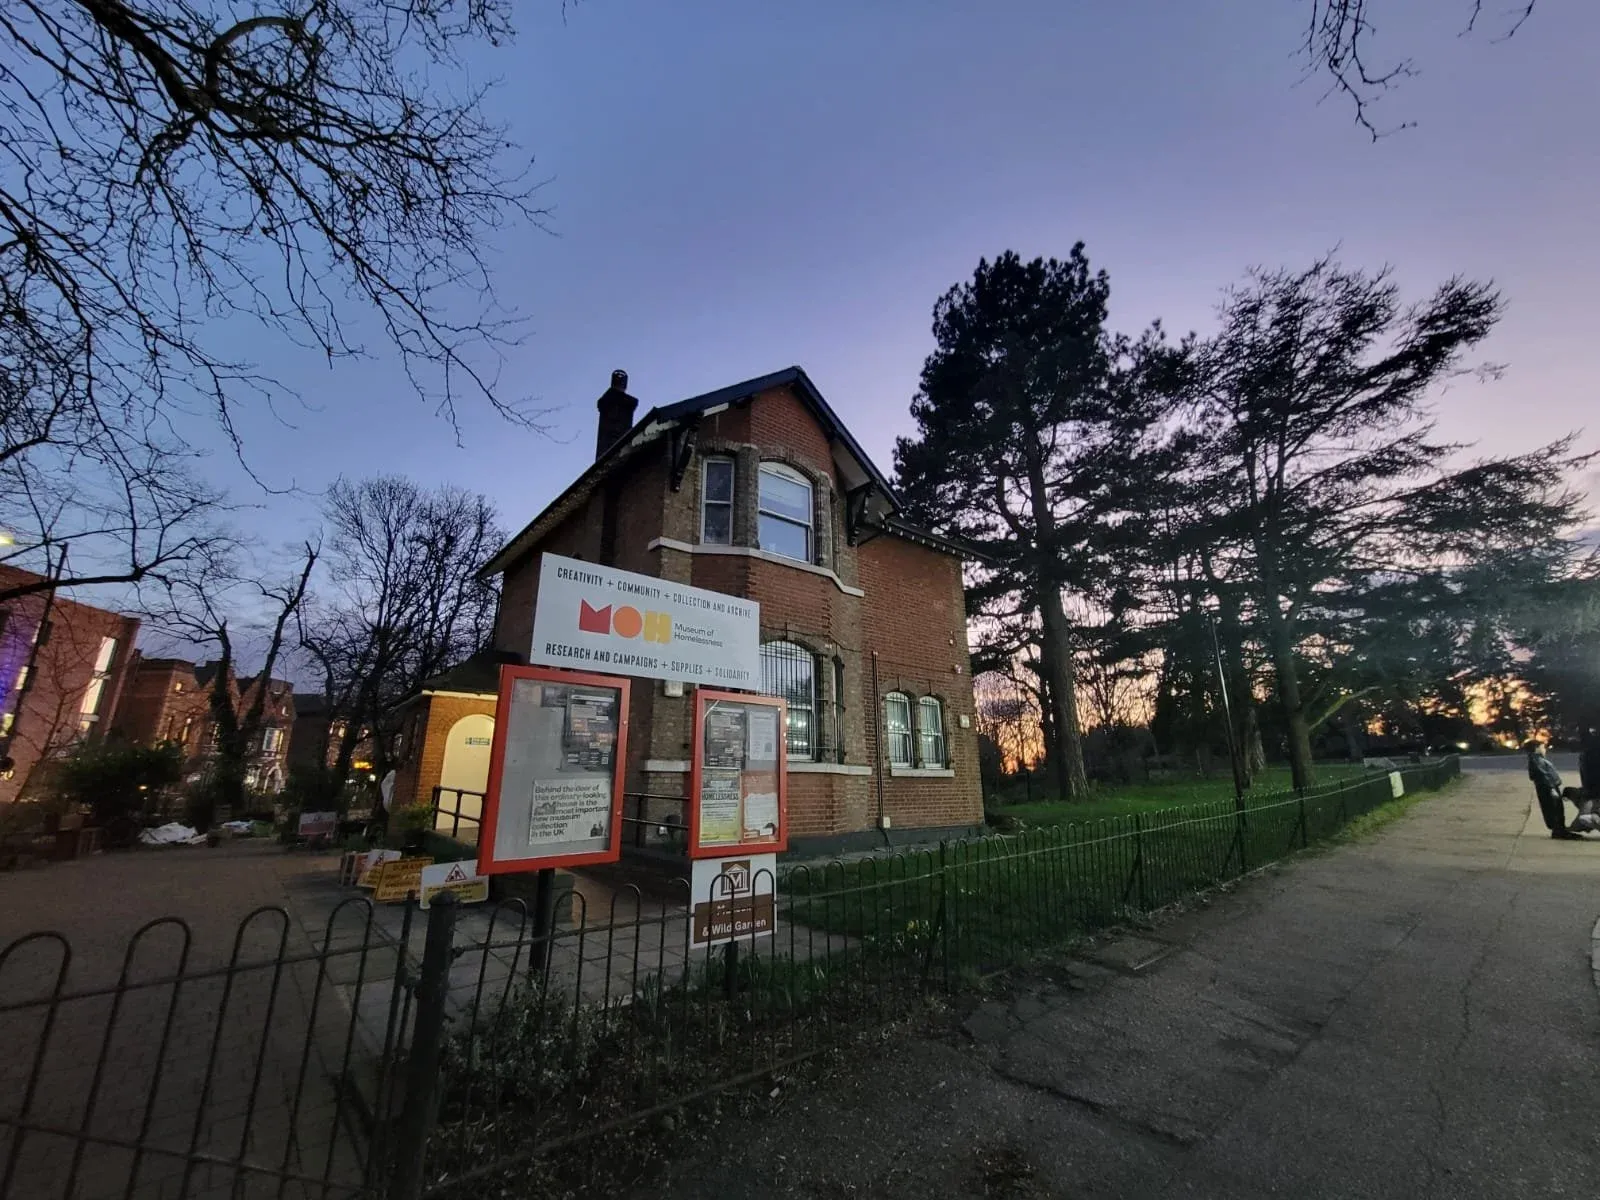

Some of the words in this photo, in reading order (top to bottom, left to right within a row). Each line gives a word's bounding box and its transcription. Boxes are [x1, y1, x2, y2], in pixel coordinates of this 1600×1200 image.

[557, 567, 604, 587] CREATIVITY
[617, 581, 660, 599] COMMUNITY
[673, 593, 711, 610] COLLECTION
[713, 602, 725, 613] AND
[727, 606, 751, 618] ARCHIVE
[579, 598, 672, 646] MOH
[674, 623, 706, 637] Museum
[707, 629, 715, 637] of
[674, 632, 723, 648] Homelessness
[545, 642, 591, 660] RESEARCH
[594, 650, 610, 663] AND
[613, 652, 658, 669] CAMPAIGNS
[671, 661, 703, 675] SUPPLIES
[715, 667, 750, 681] SOLIDARITY
[535, 785, 562, 793] Behind
[575, 805, 609, 814] important
[711, 922, 732, 935] Wild
[734, 918, 767, 931] Garen
